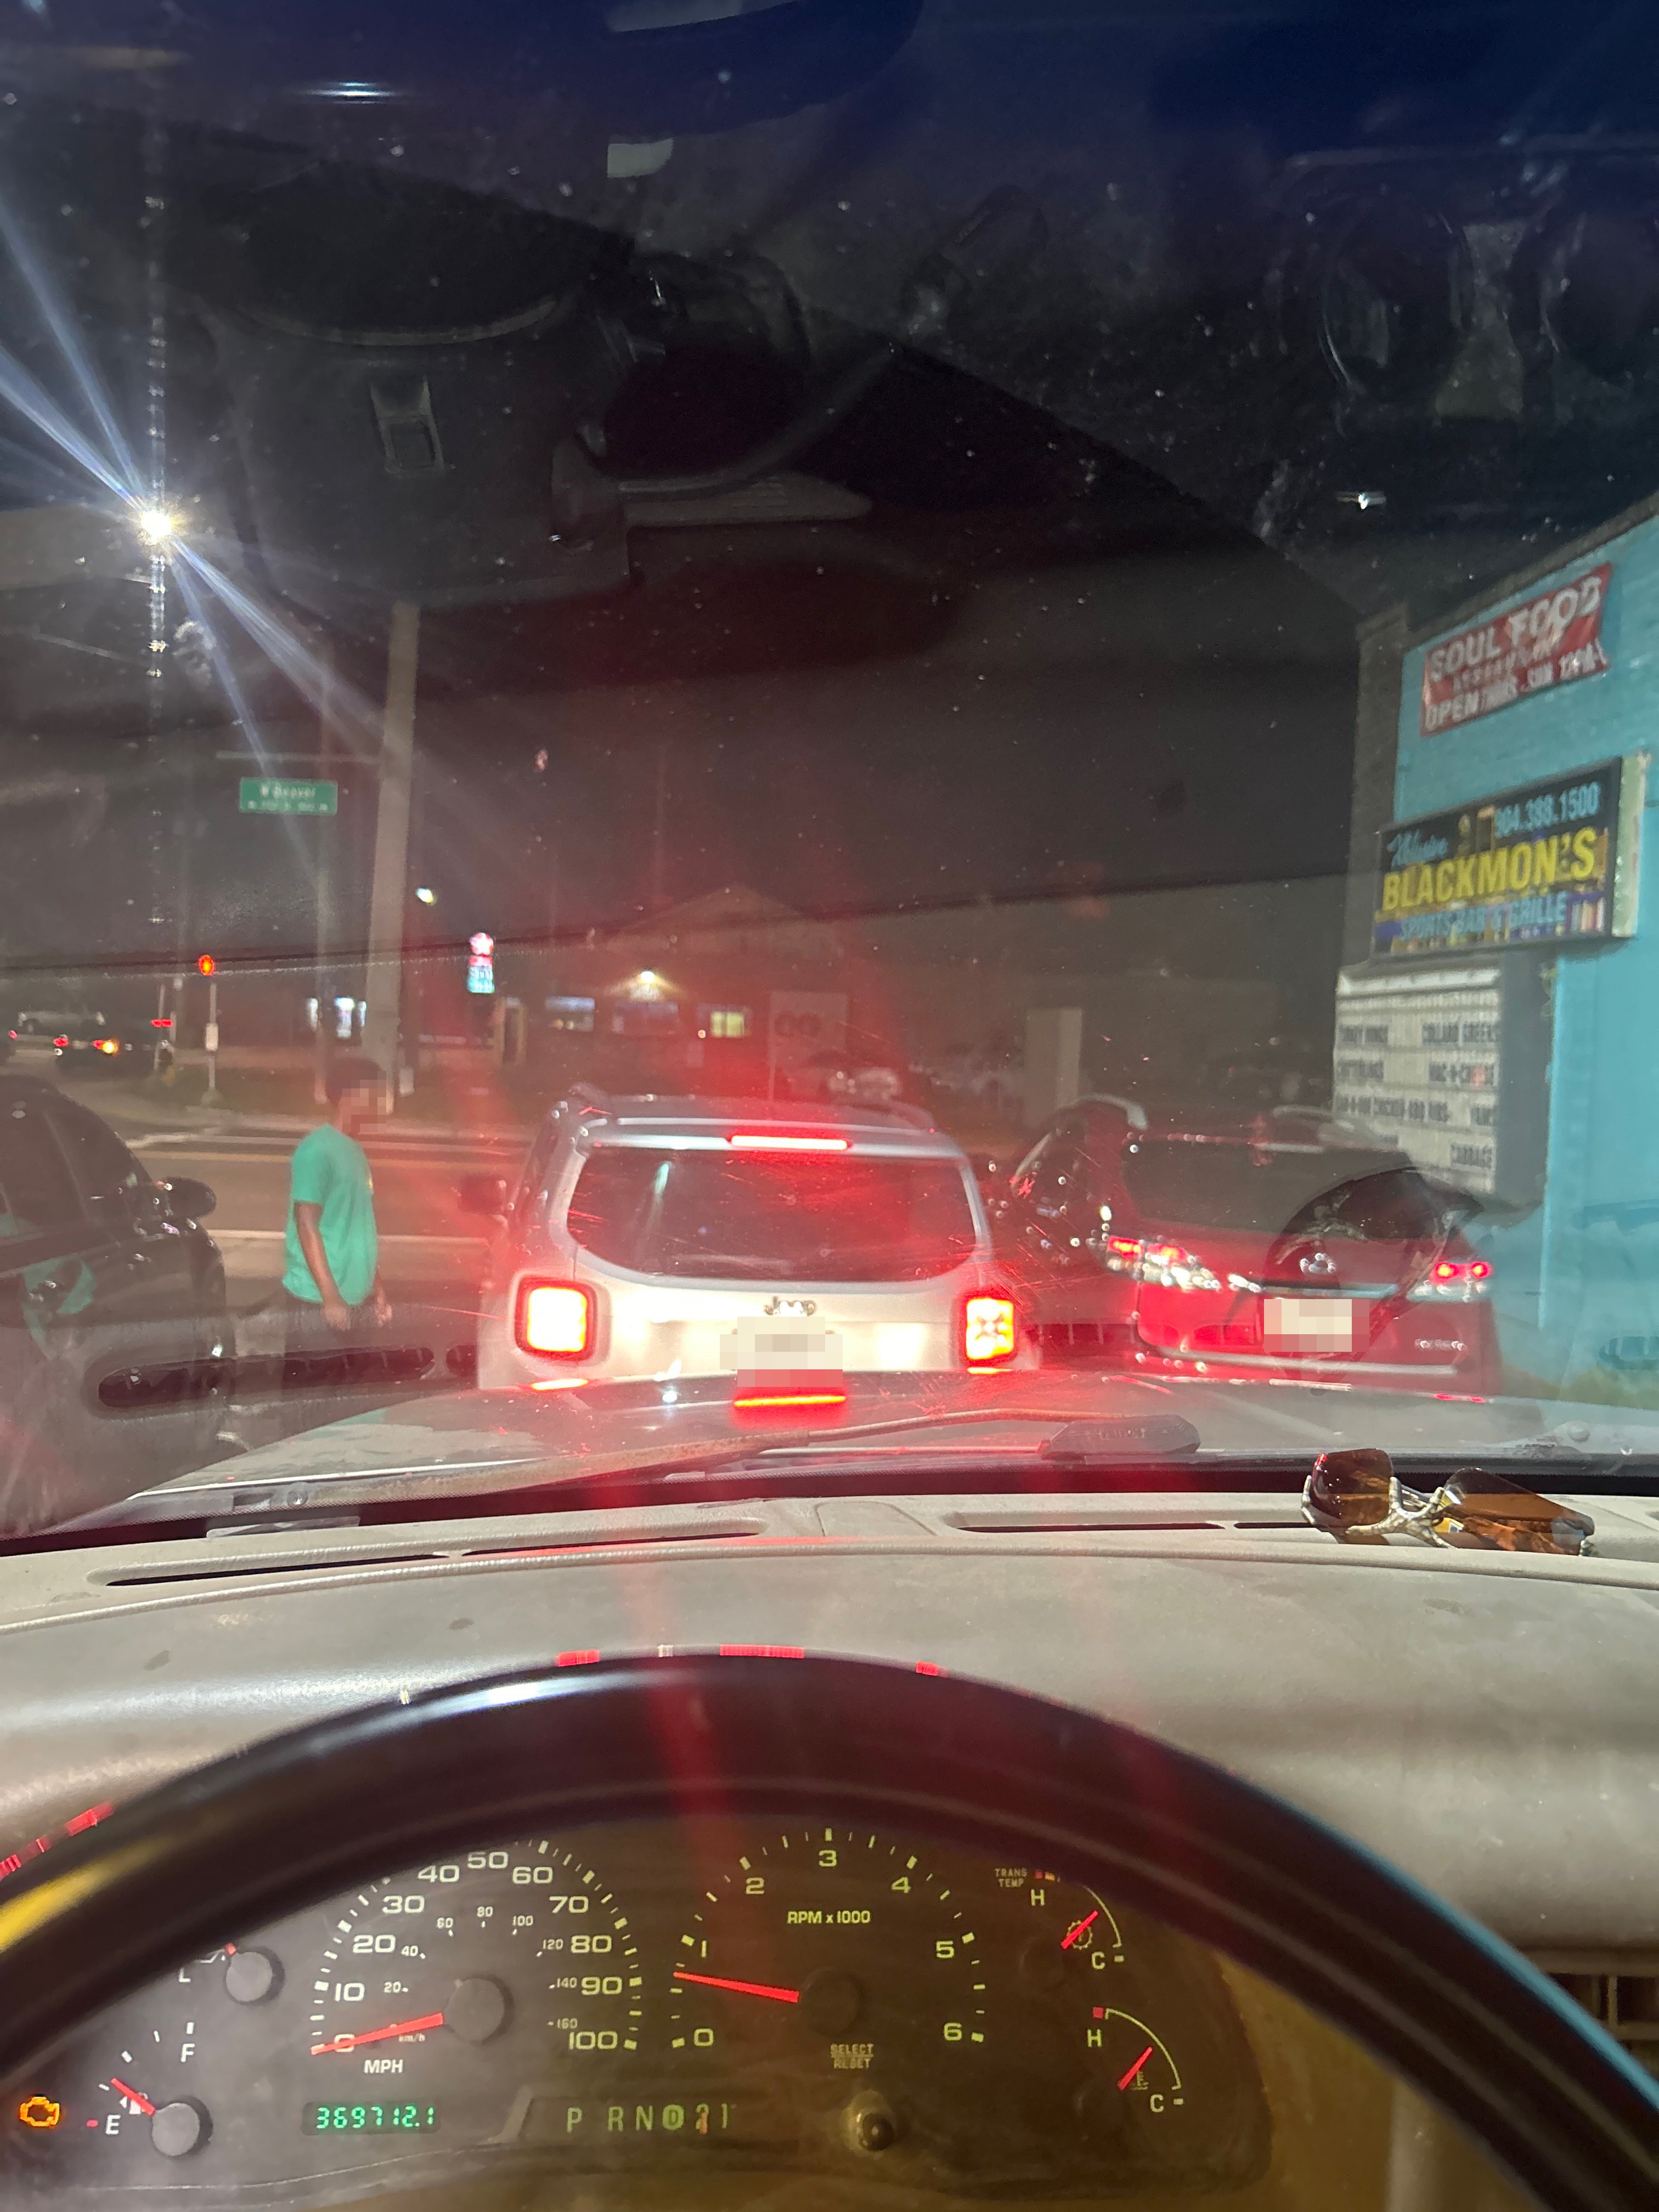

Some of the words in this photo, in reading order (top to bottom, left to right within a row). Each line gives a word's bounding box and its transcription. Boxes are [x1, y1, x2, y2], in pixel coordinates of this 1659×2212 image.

[1430, 628, 1501, 682] SOUL
[1509, 576, 1602, 645] FOOD
[1427, 691, 1480, 731] OPEN
[1381, 827, 1598, 911] BLACKMON'S
[467, 1852, 509, 1869] 50
[819, 1850, 837, 1867] 3
[417, 1865, 460, 1883] 40
[512, 1866, 553, 1884] 60
[994, 1867, 1028, 1878] TRANS
[746, 1877, 764, 1894] 2
[891, 1877, 911, 1893] 4
[998, 1878, 1024, 1888] TEMP
[382, 1895, 425, 1914] 30
[549, 1896, 589, 1914] 70
[1030, 1888, 1045, 1906] H
[477, 1906, 493, 1917] 80
[787, 1911, 822, 1924] RPM
[837, 1910, 871, 1924] 1000
[437, 1918, 454, 1929] 60
[512, 1915, 533, 1927] 100
[353, 1935, 396, 1954] 20
[401, 1945, 419, 1957] 40
[543, 1939, 563, 1950] 120
[571, 1935, 612, 1954] 80
[701, 1940, 707, 1957] 1
[935, 1940, 955, 1959] 5
[1091, 1951, 1105, 1970] C
[383, 1982, 401, 1993] 20
[557, 1977, 577, 1989] 140
[581, 1977, 622, 1995] 90
[335, 1983, 365, 2002] 10
[557, 2018, 578, 2029] 160
[943, 2022, 962, 2041] 6
[568, 2031, 618, 2050] 100
[693, 2028, 714, 2046] 0
[1087, 2029, 1102, 2047] H
[180, 2043, 195, 2062] F
[830, 2044, 874, 2054] SELECT
[364, 2059, 403, 2074] MPH
[1149, 2094, 1164, 2113] C
[105, 2114, 121, 2135] E
[317, 2106, 434, 2129] 369712.1
[567, 2107, 583, 2133] P
[607, 2106, 624, 2132] R
[636, 2106, 654, 2131] N
